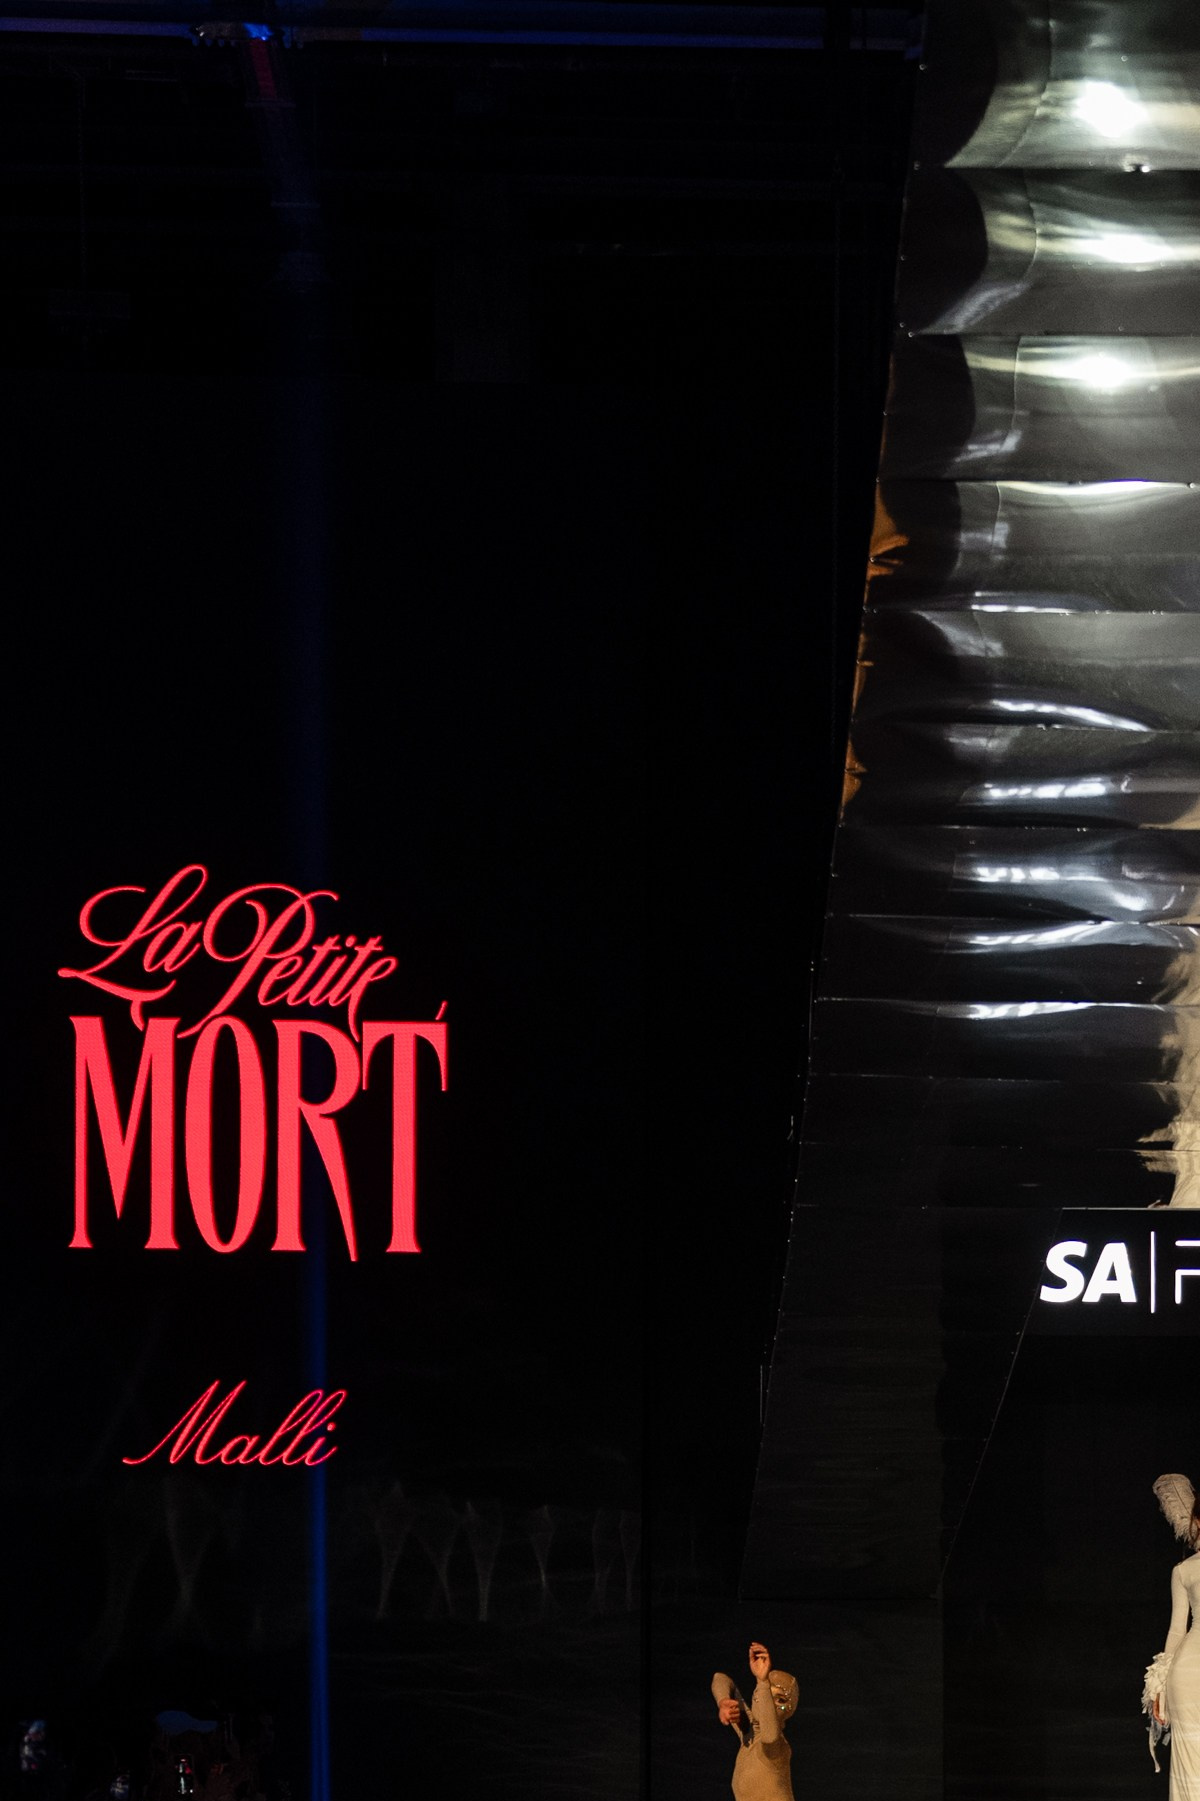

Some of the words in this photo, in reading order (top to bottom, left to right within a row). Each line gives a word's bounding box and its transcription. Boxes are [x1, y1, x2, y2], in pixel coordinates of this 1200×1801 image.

[57, 863, 208, 1032] La
[176, 882, 398, 1042] Petite
[68, 1014, 449, 1262] MORT
[121, 1379, 348, 1467] Malli
